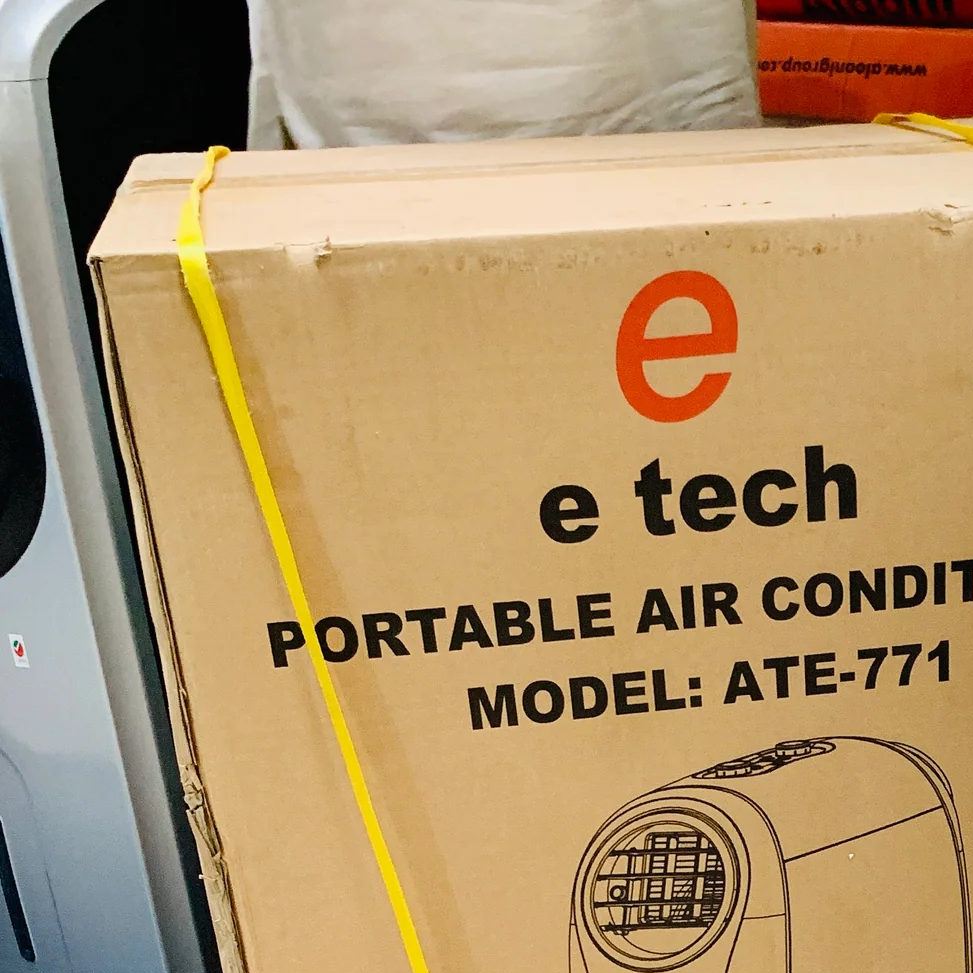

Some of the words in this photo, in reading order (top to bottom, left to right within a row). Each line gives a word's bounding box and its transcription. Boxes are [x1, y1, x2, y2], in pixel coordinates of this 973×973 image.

[757, 57, 927, 79] www.aloonigroup.co
[615, 269, 738, 422] e
[540, 484, 600, 544] e
[634, 446, 858, 535] tech
[266, 593, 615, 668] PORTABLE
[637, 582, 743, 634] AIR
[468, 669, 703, 731] MODEL:
[723, 640, 950, 705] ATE-771
